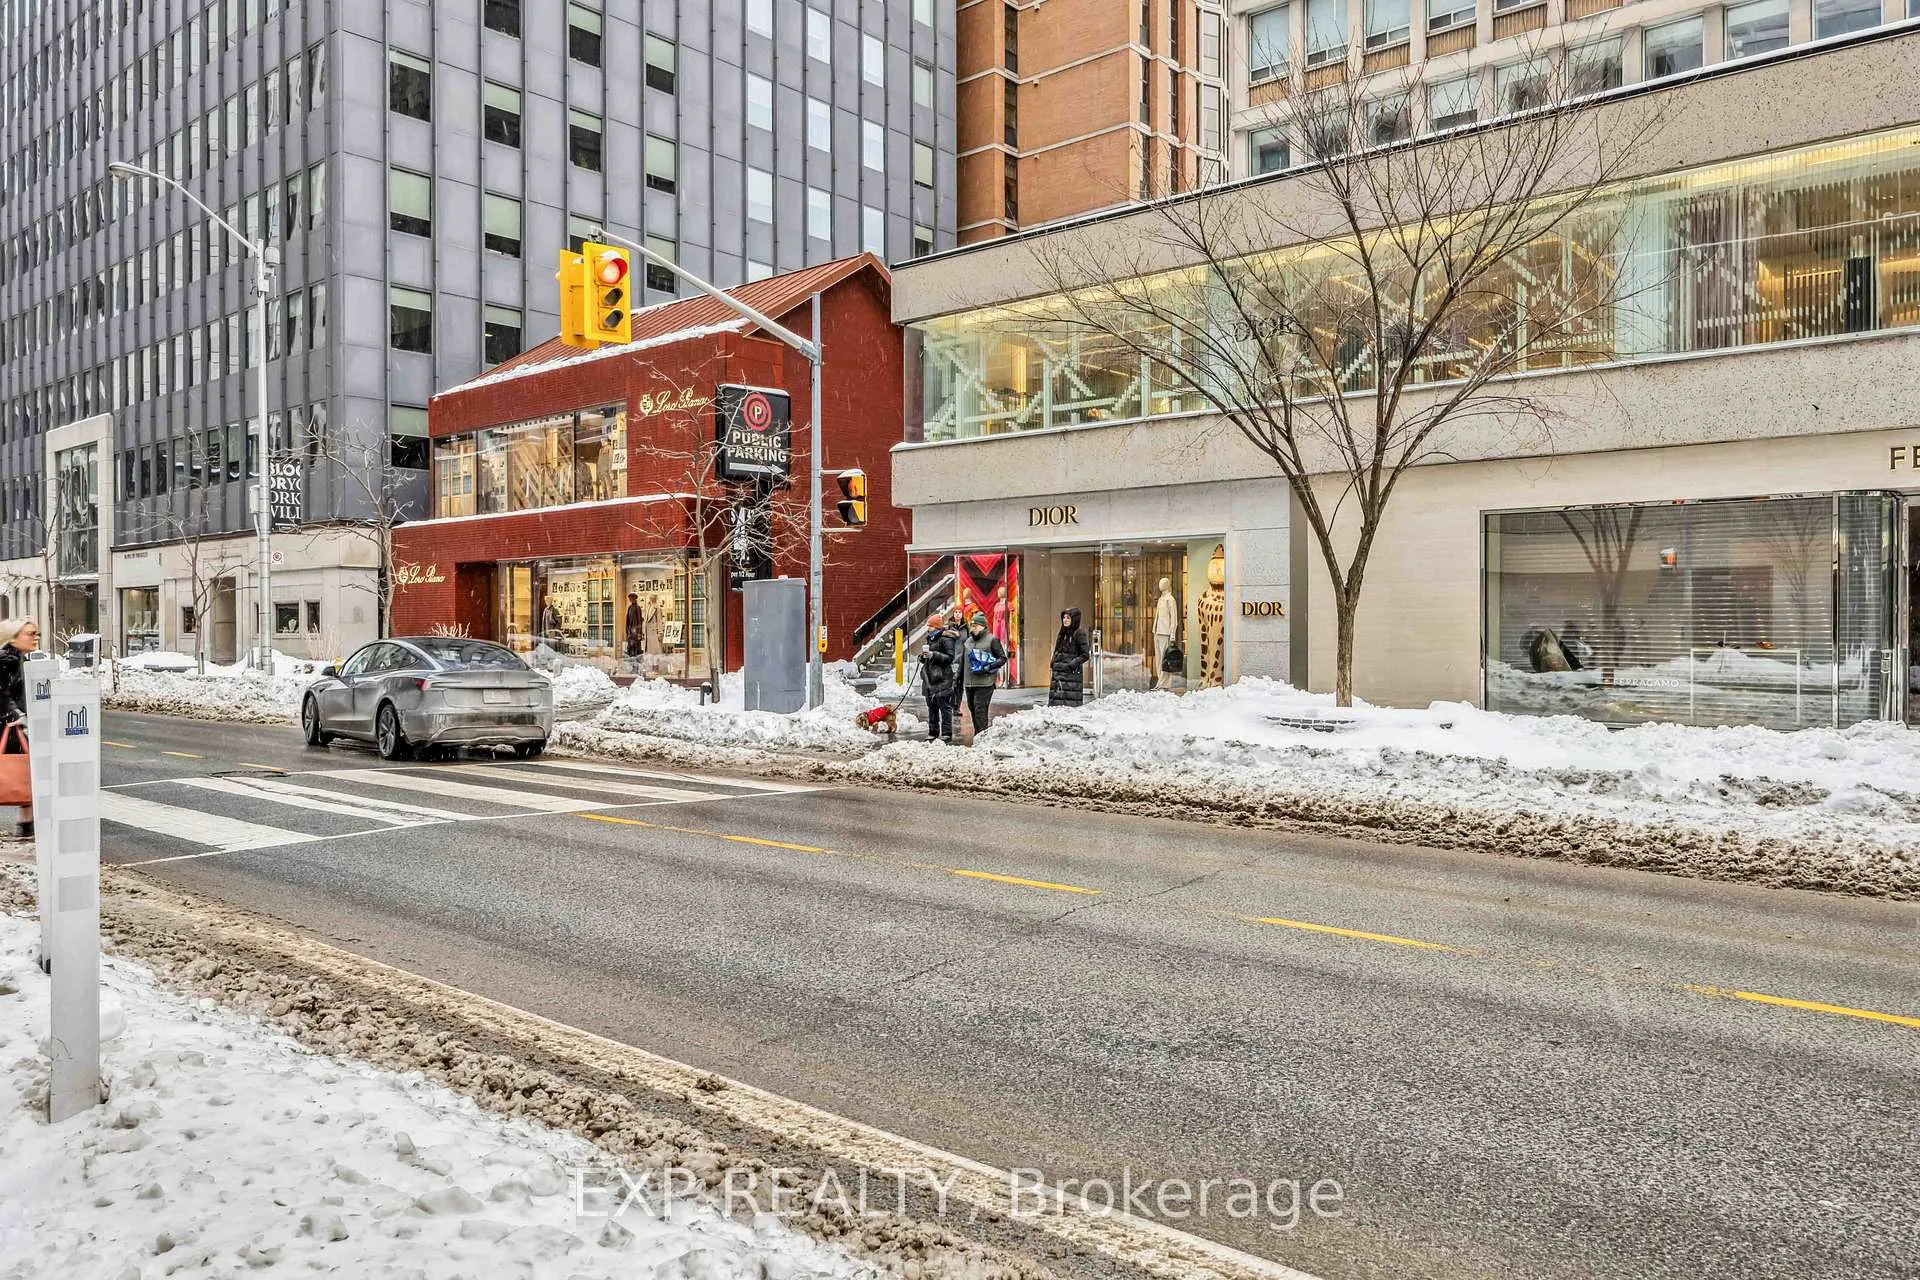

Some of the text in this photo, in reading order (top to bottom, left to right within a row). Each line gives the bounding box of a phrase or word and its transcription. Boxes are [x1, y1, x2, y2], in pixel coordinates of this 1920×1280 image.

[732, 430, 782, 448] PUBLIC
[727, 446, 787, 463] PARKING
[1028, 505, 1079, 527] DIOR
[1241, 601, 1285, 616] DIOR
